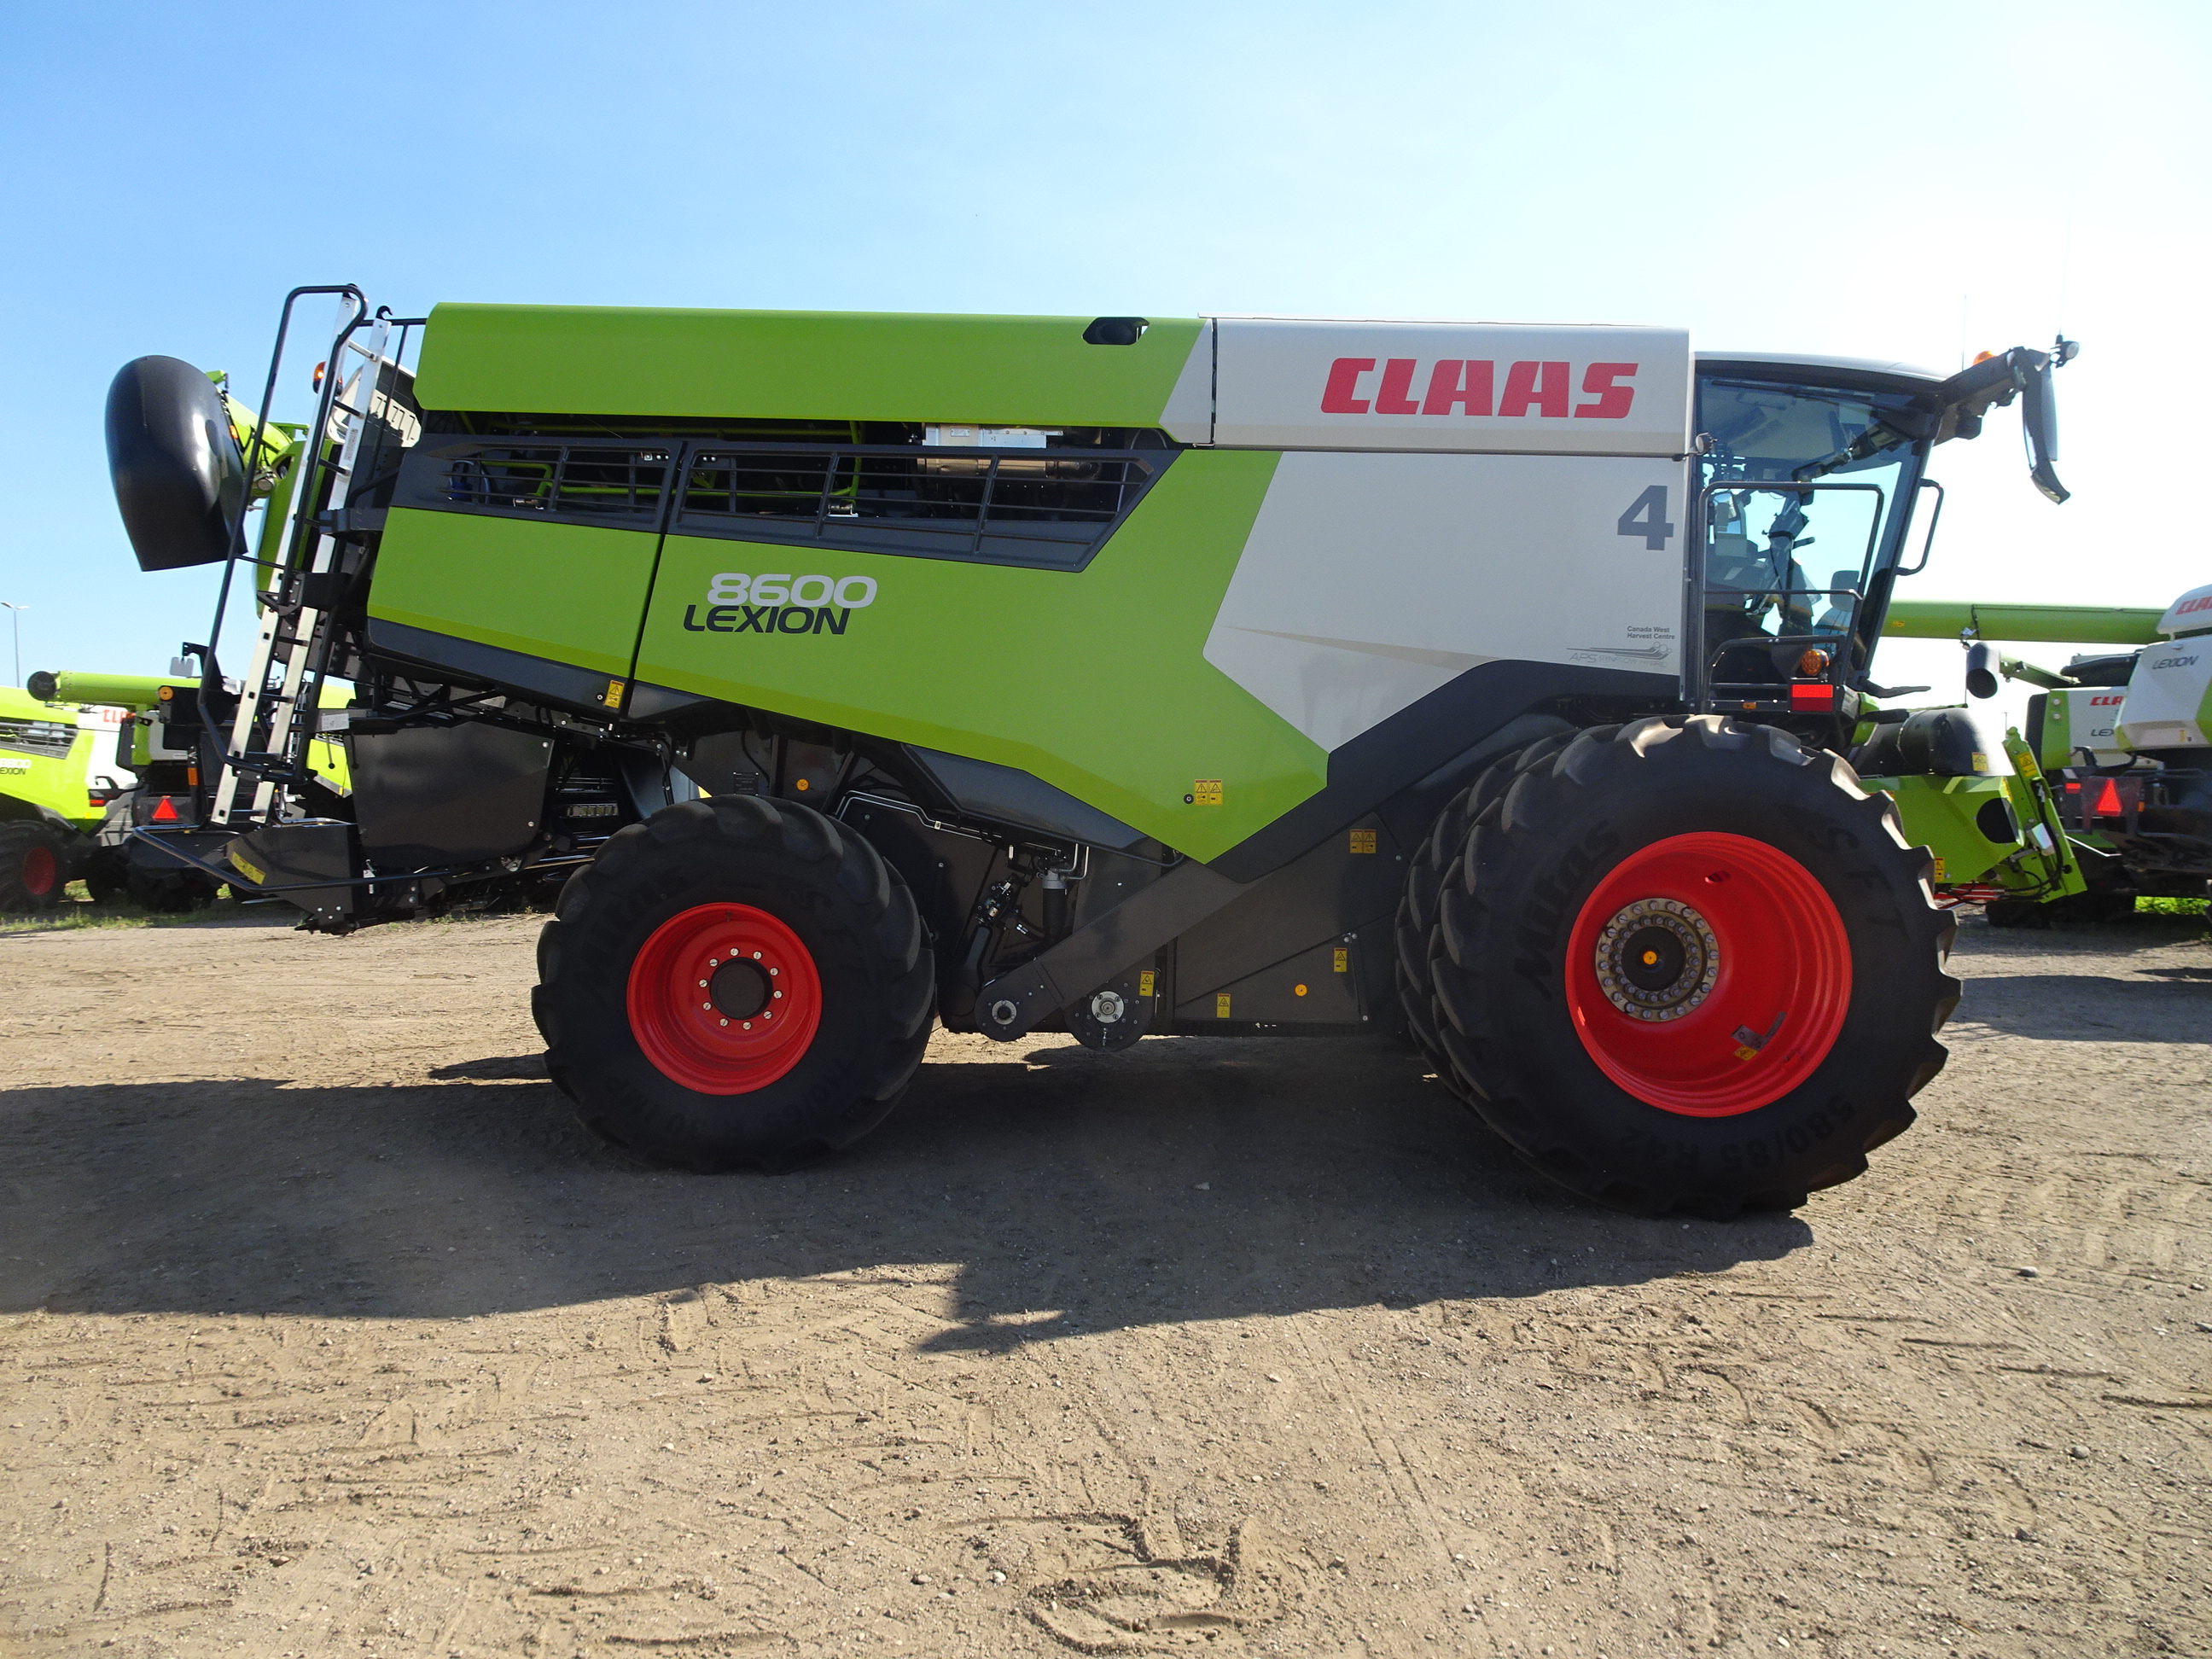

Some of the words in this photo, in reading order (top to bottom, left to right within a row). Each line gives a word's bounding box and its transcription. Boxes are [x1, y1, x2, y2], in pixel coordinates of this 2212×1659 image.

[1321, 358, 1639, 419] CLAAS
[1617, 485, 1674, 550] 4
[707, 573, 877, 608] 8600
[684, 604, 851, 635] LEXION
[1569, 652, 1598, 663] APS
[2151, 655, 2200, 670] LEXION
[1513, 817, 1622, 1004] Mitas
